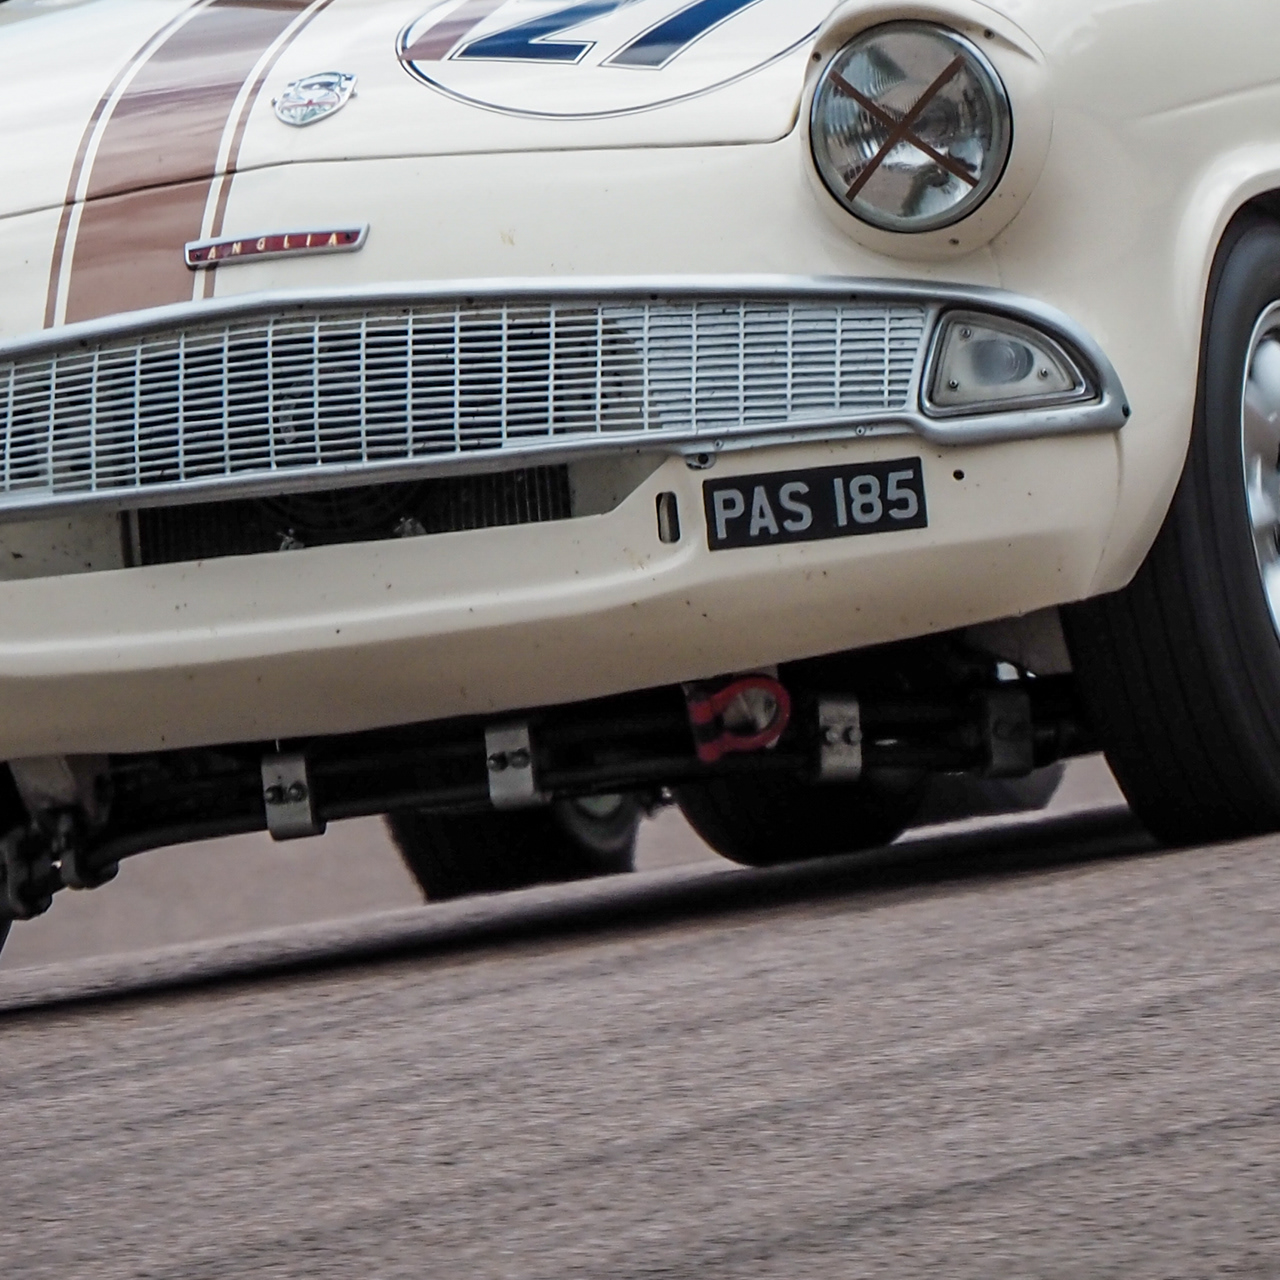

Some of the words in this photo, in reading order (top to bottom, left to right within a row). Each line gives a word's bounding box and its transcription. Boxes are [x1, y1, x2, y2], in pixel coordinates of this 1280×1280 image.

[206, 232, 339, 260] ANGLIA
[712, 480, 813, 540] PAS
[833, 469, 919, 528] 185
